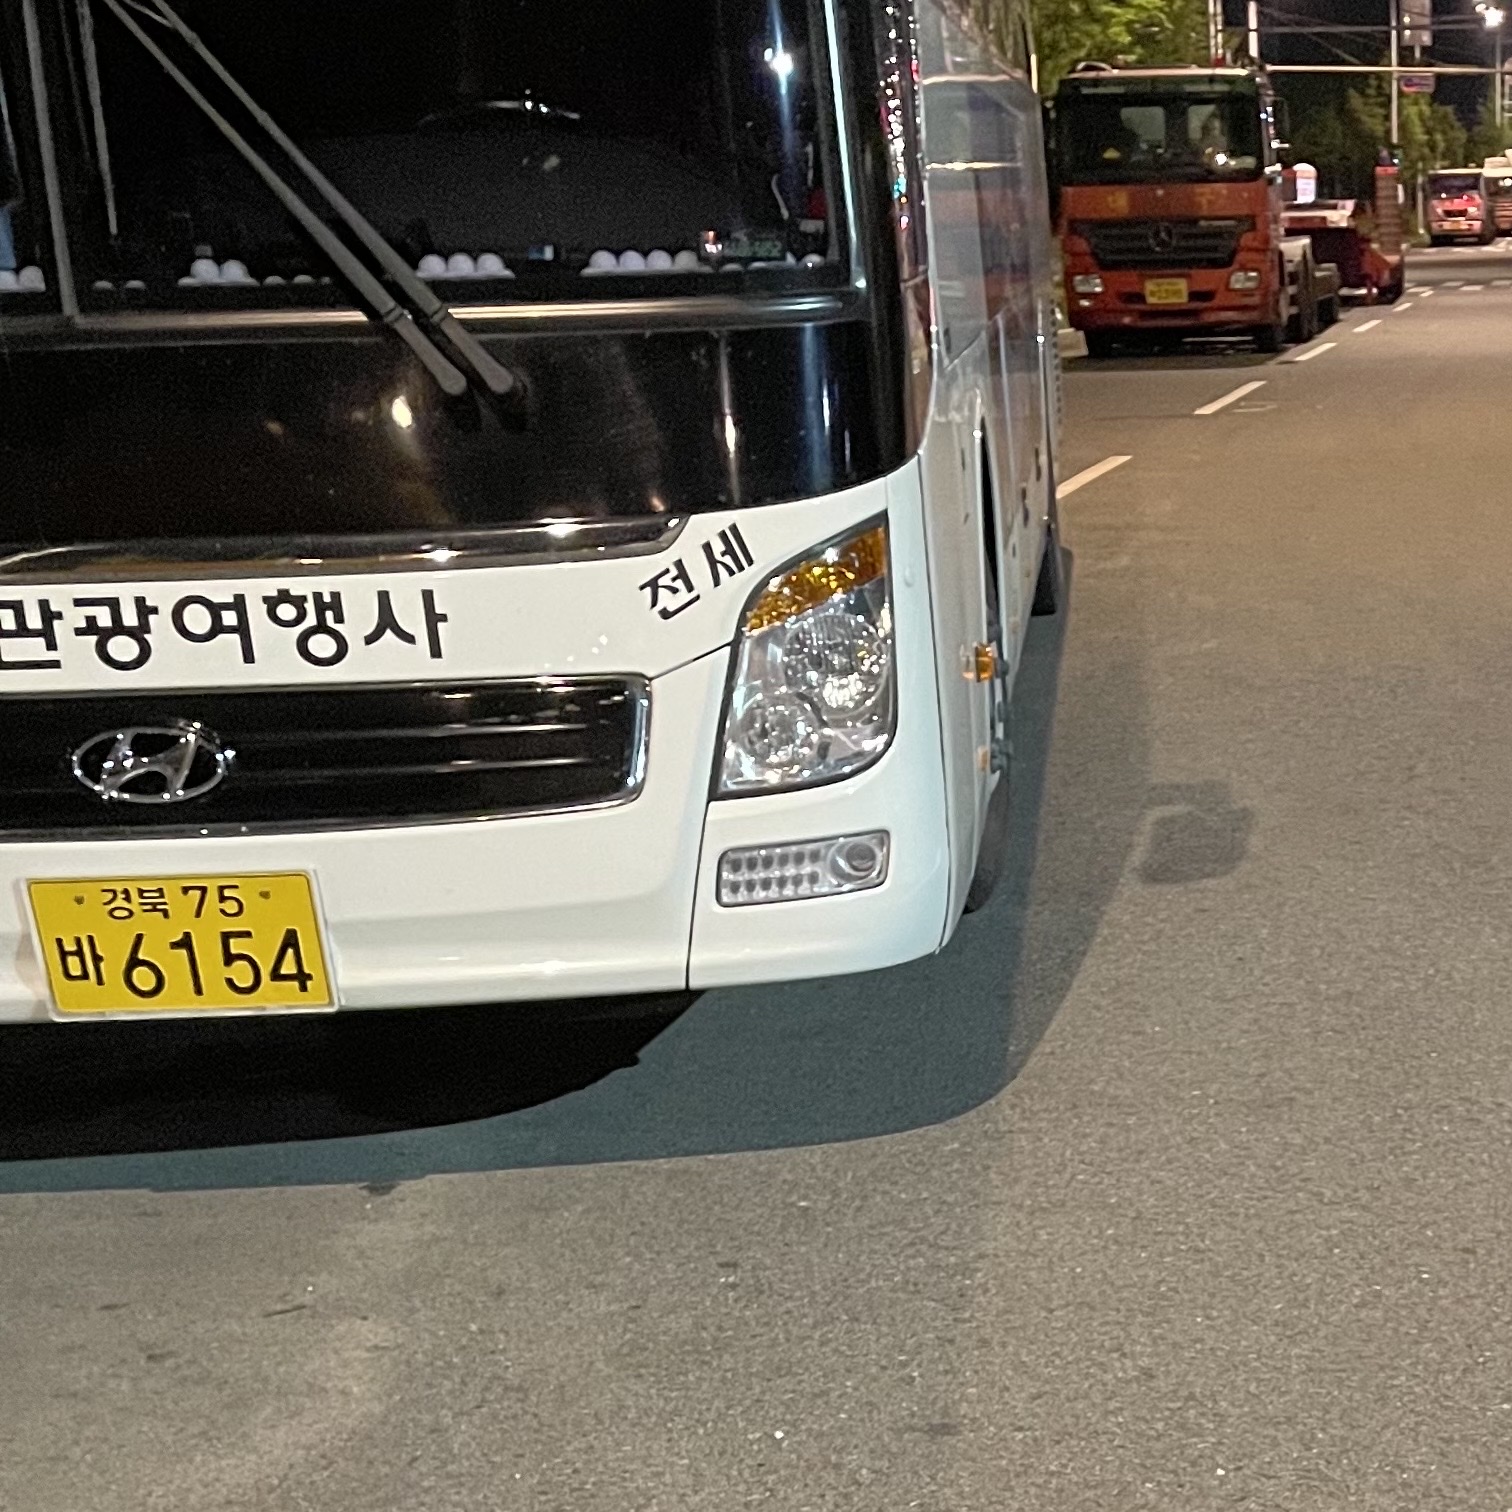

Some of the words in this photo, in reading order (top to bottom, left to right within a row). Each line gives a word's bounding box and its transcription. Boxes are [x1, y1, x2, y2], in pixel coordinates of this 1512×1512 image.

[638, 522, 754, 621] 전세
[100, 887, 170, 921] 경북
[181, 885, 244, 919] 75
[55, 934, 106, 987] 바
[123, 928, 314, 999] 6154
